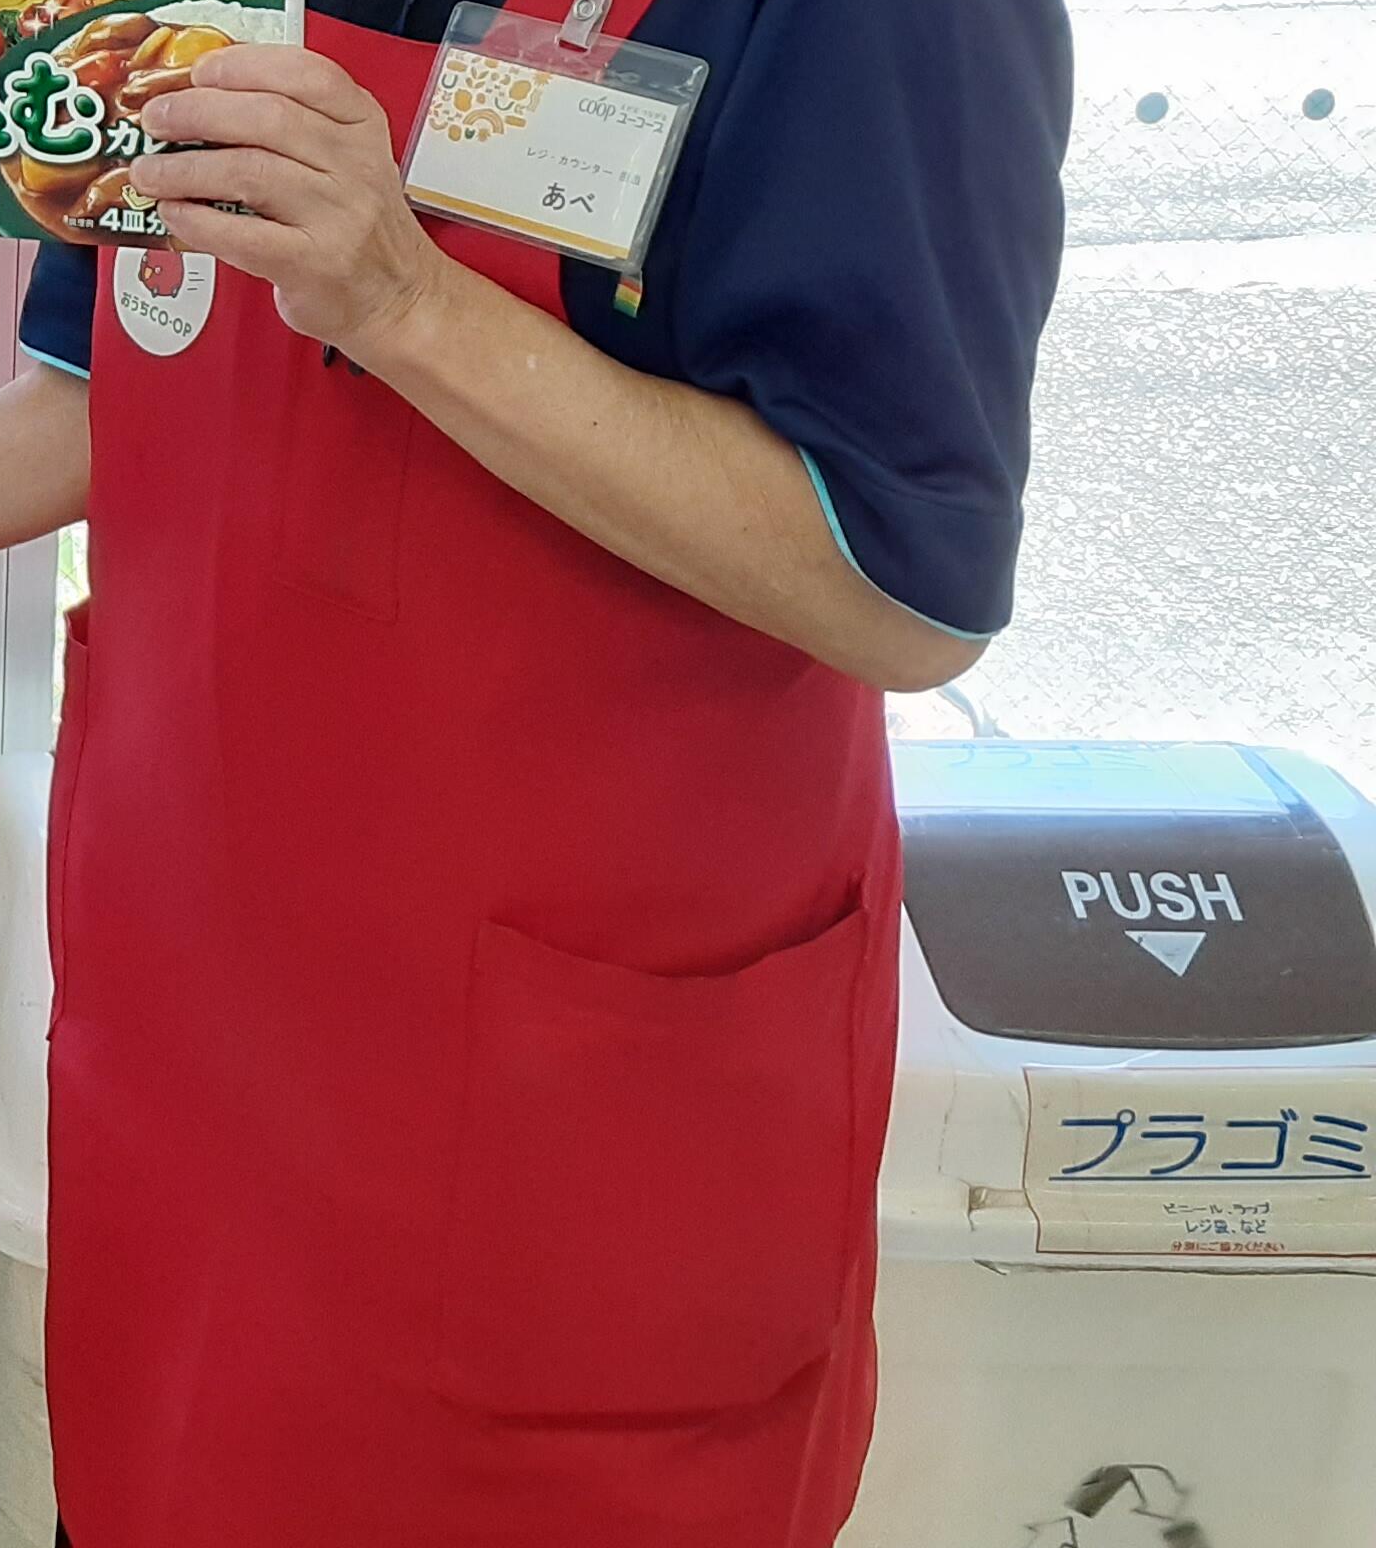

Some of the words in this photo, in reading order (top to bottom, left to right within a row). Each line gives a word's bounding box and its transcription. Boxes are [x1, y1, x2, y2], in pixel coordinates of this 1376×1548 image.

[541, 182, 596, 214] あべ
[1060, 869, 1245, 922] PUSH
[1059, 1108, 1368, 1176] プラゴミ
